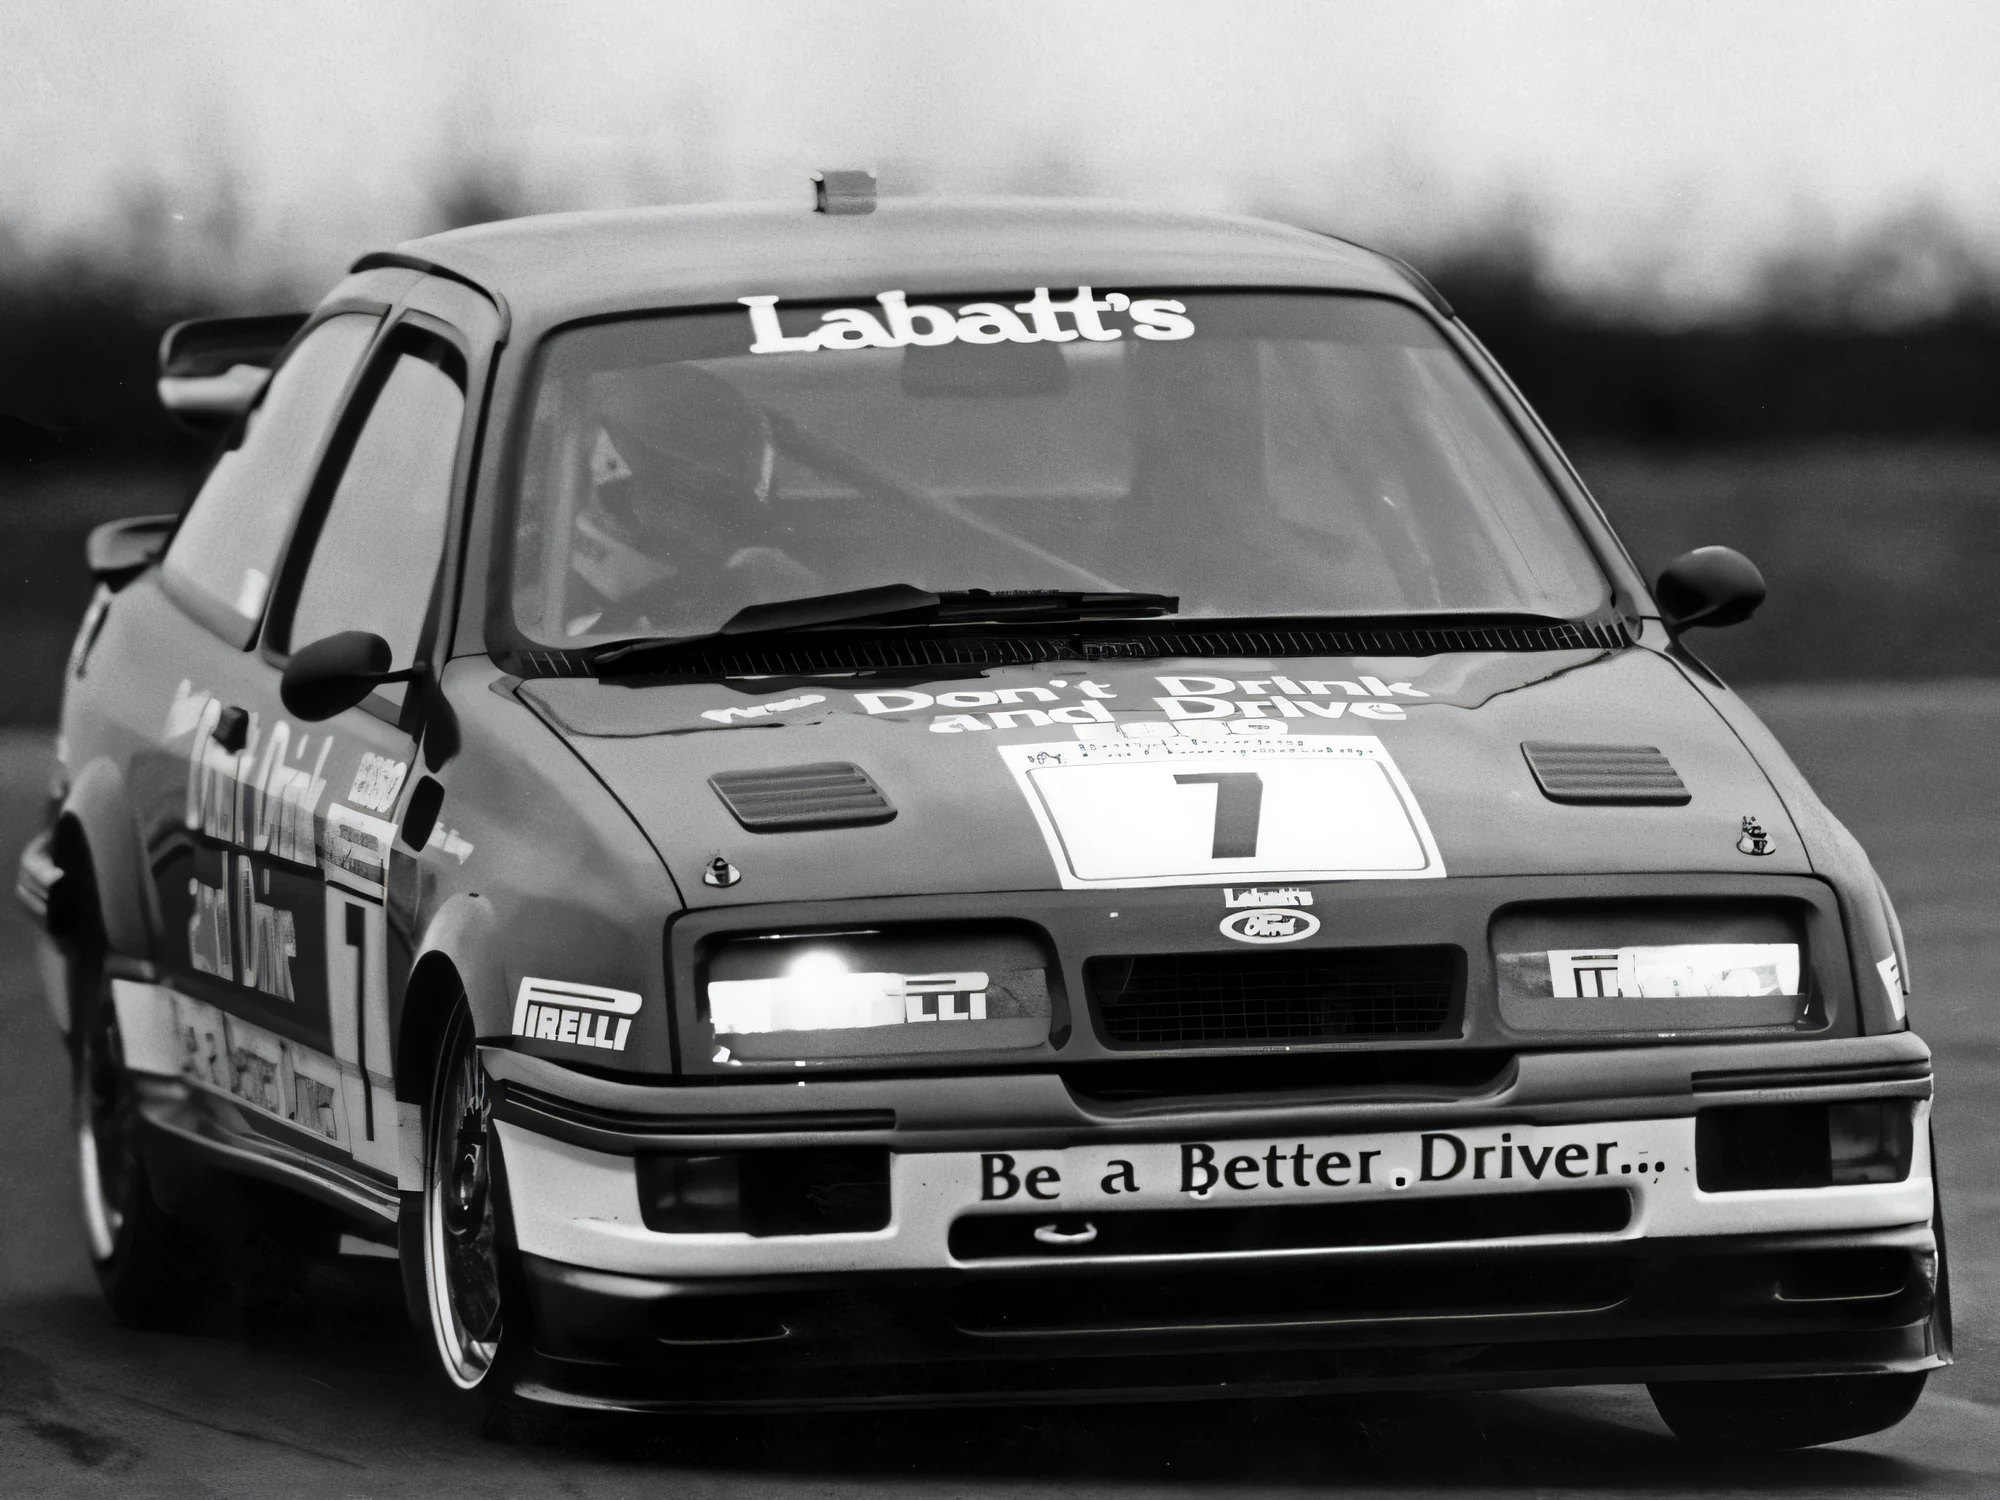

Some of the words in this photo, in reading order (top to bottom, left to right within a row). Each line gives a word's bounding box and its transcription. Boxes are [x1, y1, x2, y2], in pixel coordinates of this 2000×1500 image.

[738, 285, 1195, 354] Labatt's
[853, 680, 1118, 715] Don't
[1154, 676, 1430, 697] Drink
[928, 699, 1116, 733] and
[1152, 695, 1408, 721] Drive
[1172, 772, 1263, 860] 7
[511, 976, 643, 1051] PIRELLI
[979, 1152, 1061, 1201] Be
[1100, 1158, 1140, 1195] a
[1179, 1142, 1382, 1194] Better
